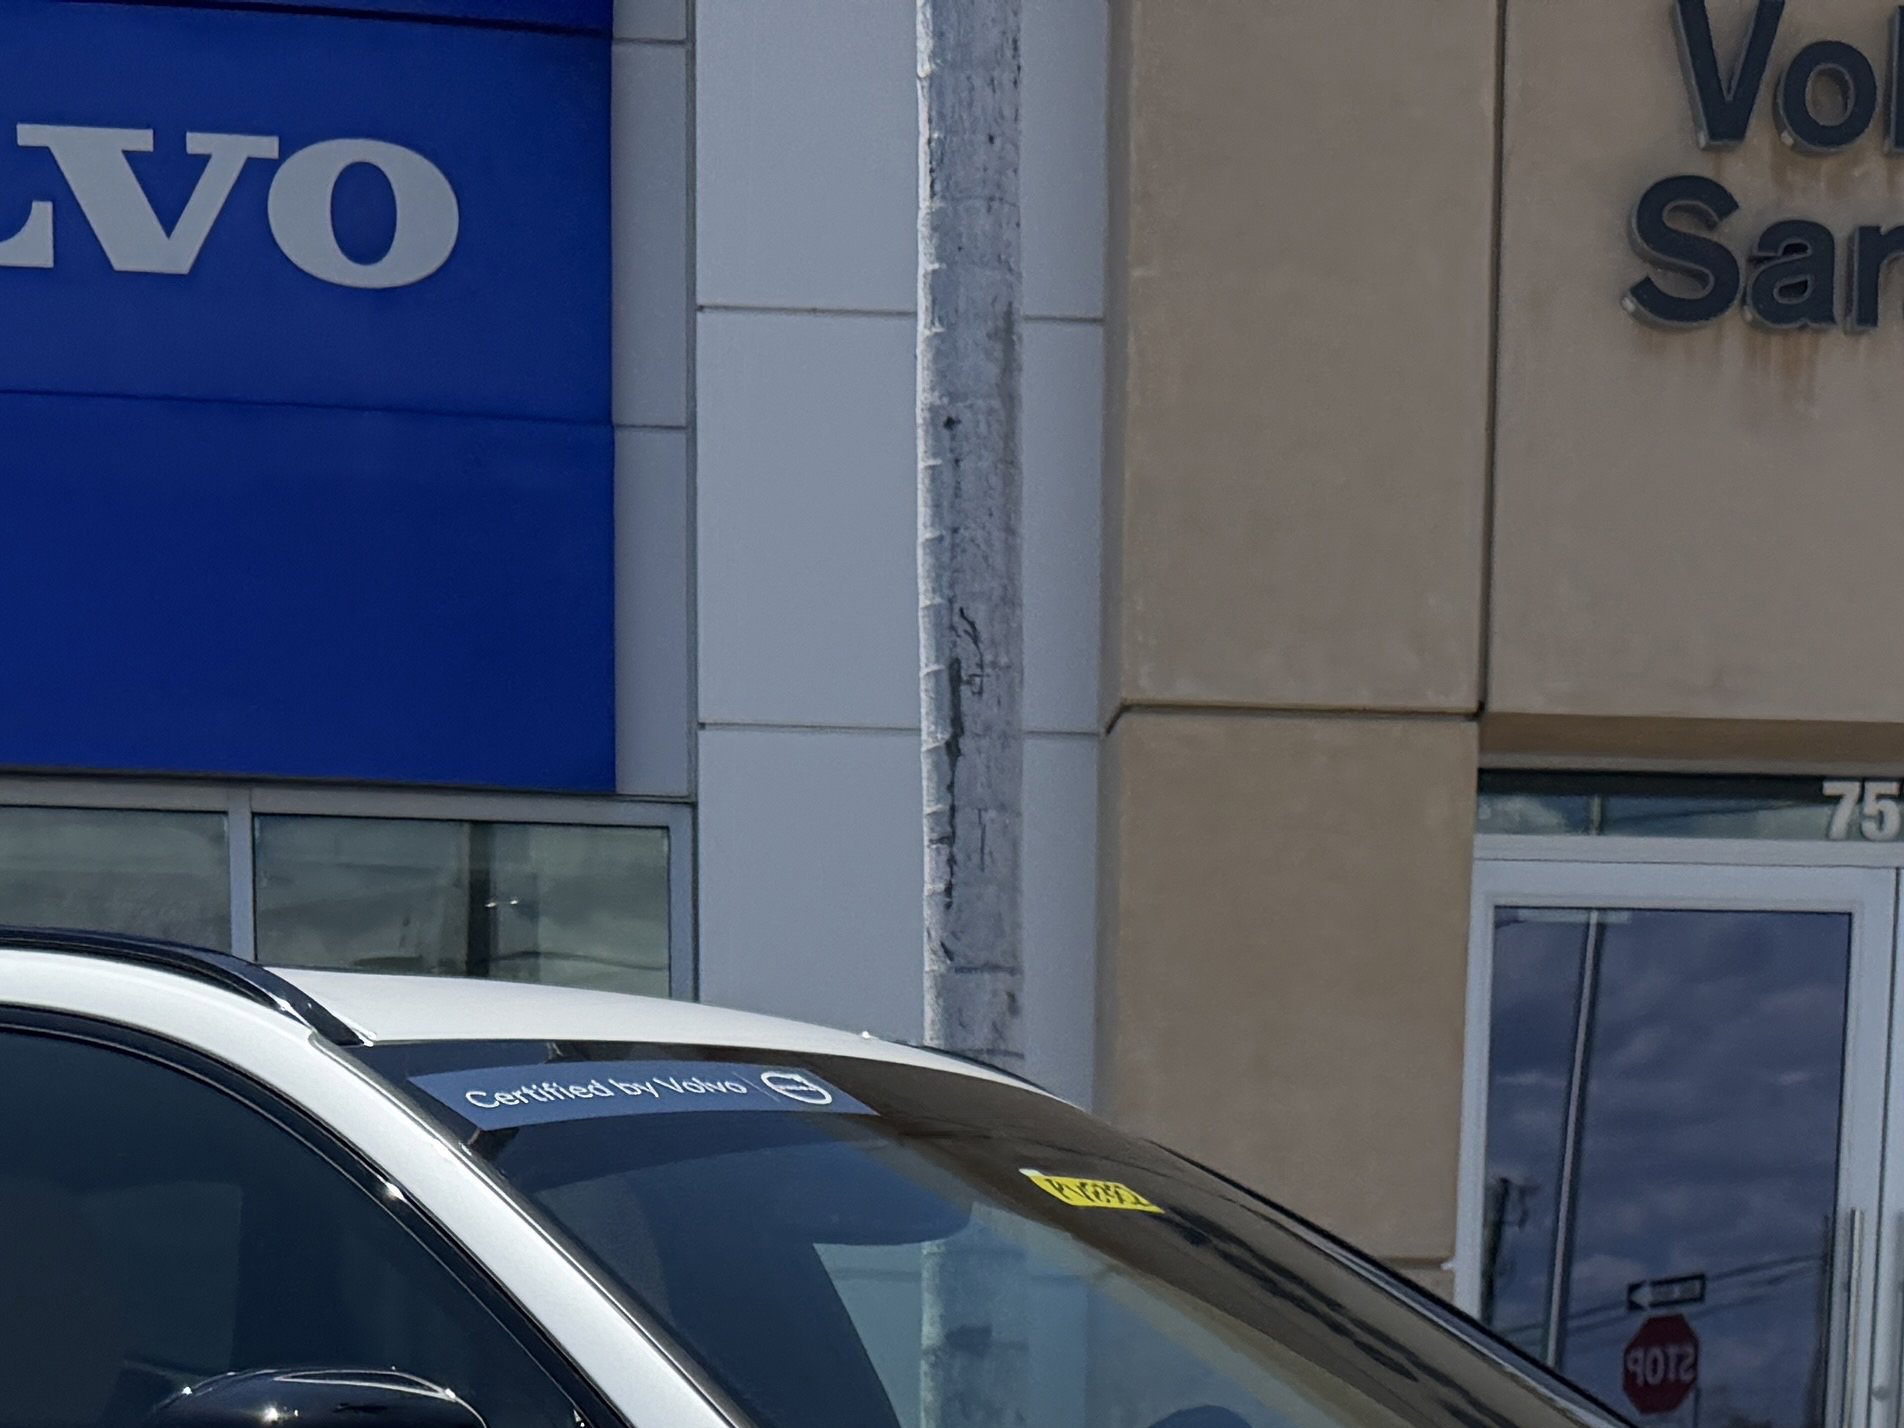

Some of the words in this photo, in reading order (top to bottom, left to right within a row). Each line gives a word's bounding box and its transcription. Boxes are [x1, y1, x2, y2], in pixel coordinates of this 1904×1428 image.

[465, 1079, 613, 1110] Certified
[611, 1079, 660, 1099] by
[653, 1077, 748, 1094] Volvo
